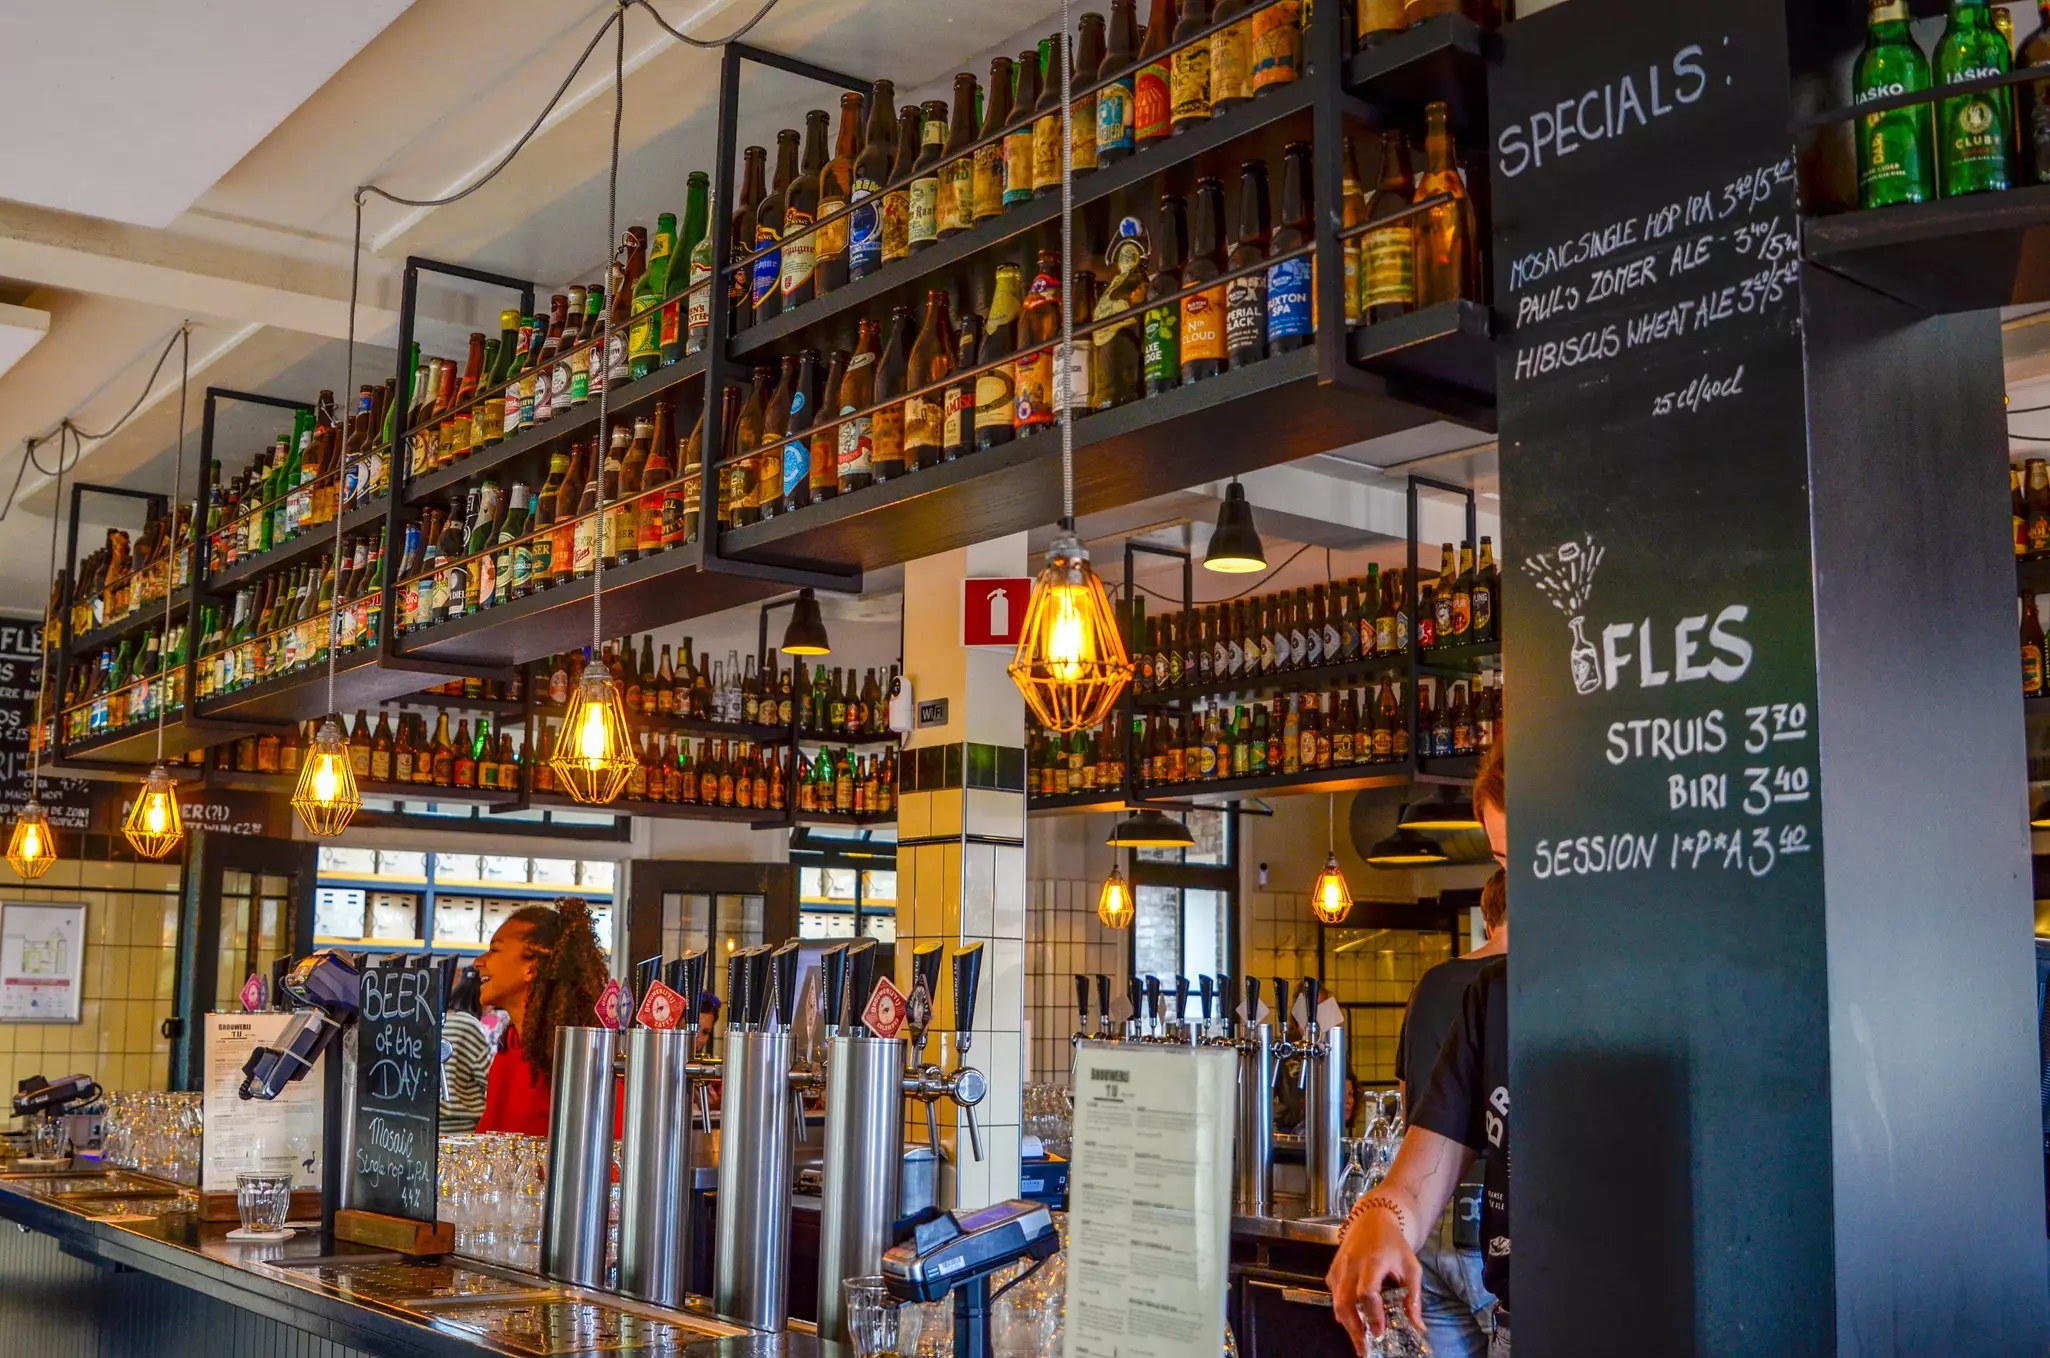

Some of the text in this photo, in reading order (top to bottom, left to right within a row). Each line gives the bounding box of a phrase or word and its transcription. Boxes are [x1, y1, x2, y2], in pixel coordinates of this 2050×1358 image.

[1644, 204, 1682, 241] HOP
[1685, 190, 1713, 226] IPA
[1586, 256, 1657, 304] ZOMER
[1670, 235, 1714, 277] ALE
[1272, 304, 1291, 317] SPA
[1514, 324, 1620, 381] HIBISCUS
[1626, 301, 1696, 348] WHEAT
[1694, 286, 1736, 330] ALE
[1182, 330, 1216, 345] CLOUD
[1602, 604, 1753, 691] FLES
[1606, 708, 1728, 765] STRUIS
[1668, 772, 1728, 811] BIRI
[1533, 832, 1660, 879] SESSION
[360, 968, 436, 1027] BEER
[375, 1022, 423, 1060] of the
[368, 1116, 414, 1161] Mosaic
